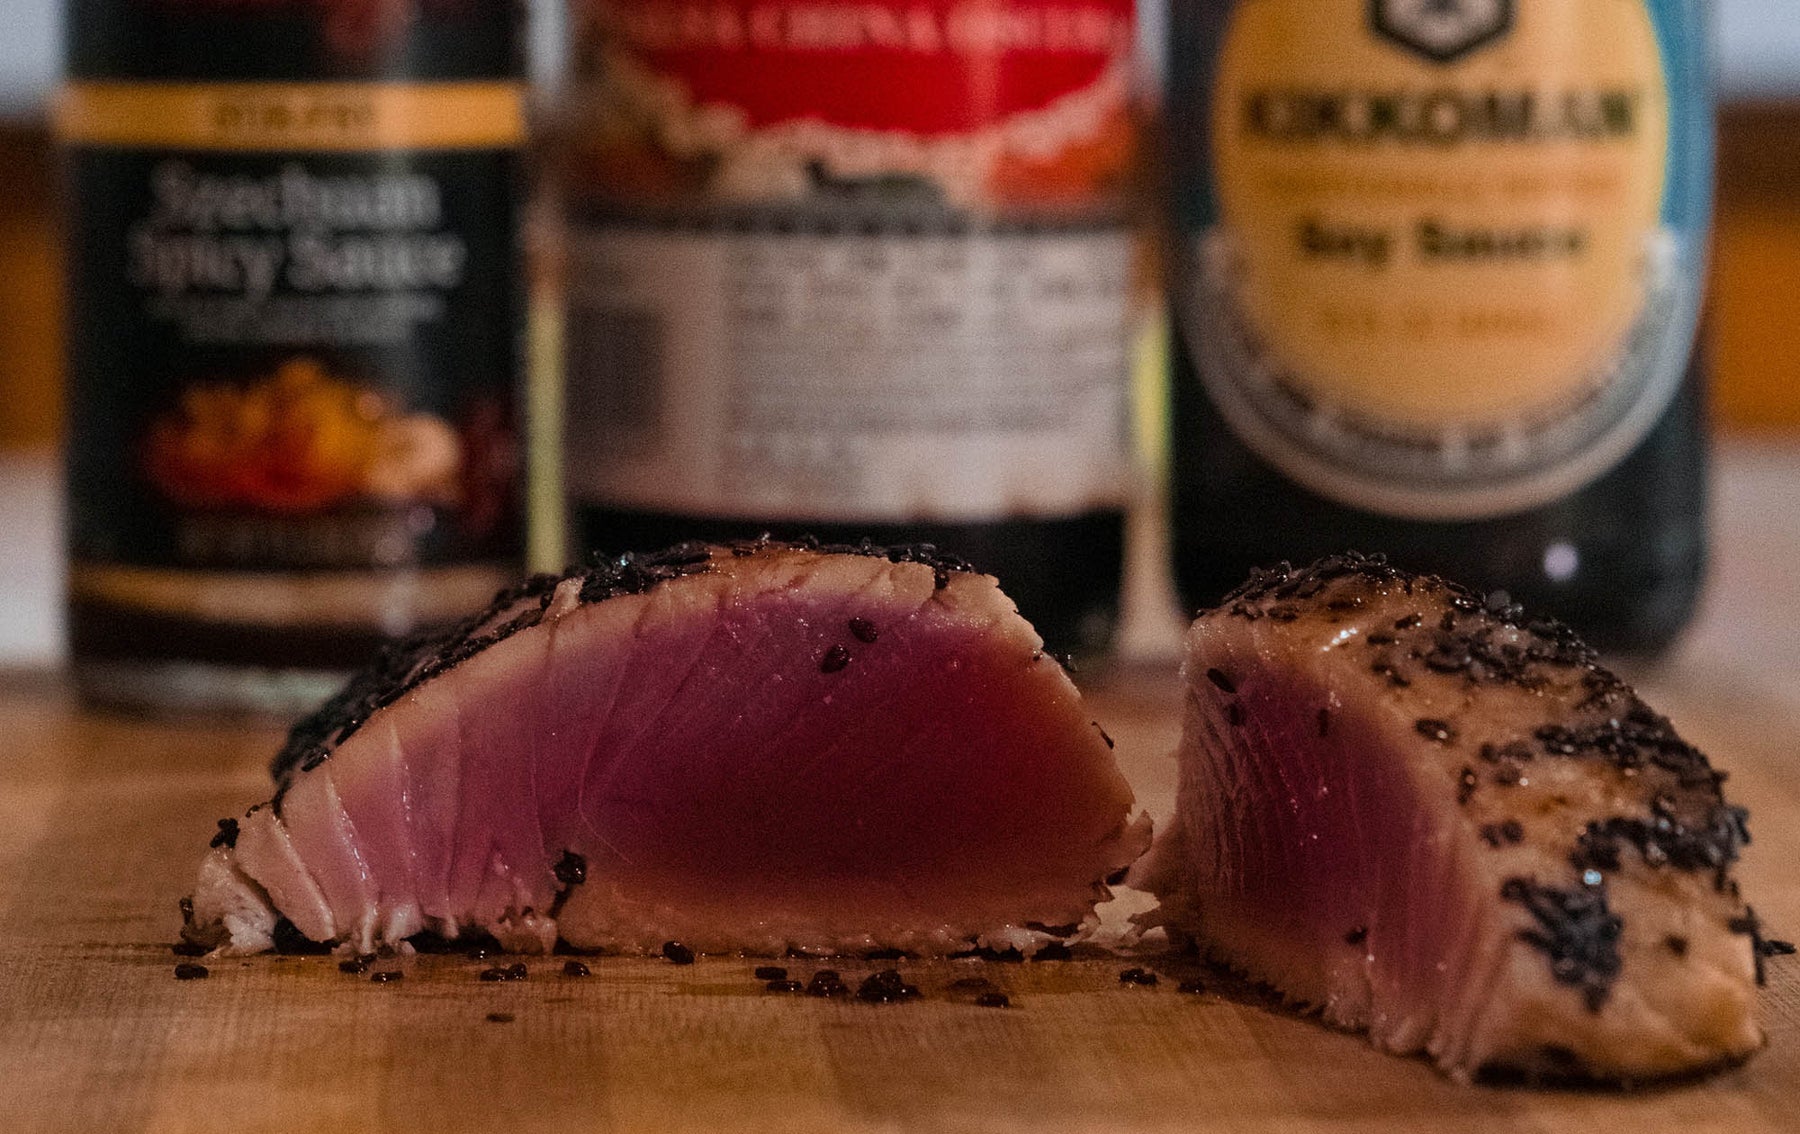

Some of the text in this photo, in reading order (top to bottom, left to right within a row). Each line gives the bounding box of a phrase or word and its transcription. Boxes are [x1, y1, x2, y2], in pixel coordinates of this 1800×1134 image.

[1244, 88, 1640, 144] KIKKOMAN
[287, 226, 466, 290] Sauce
[1298, 214, 1590, 268] Soy Sauce
